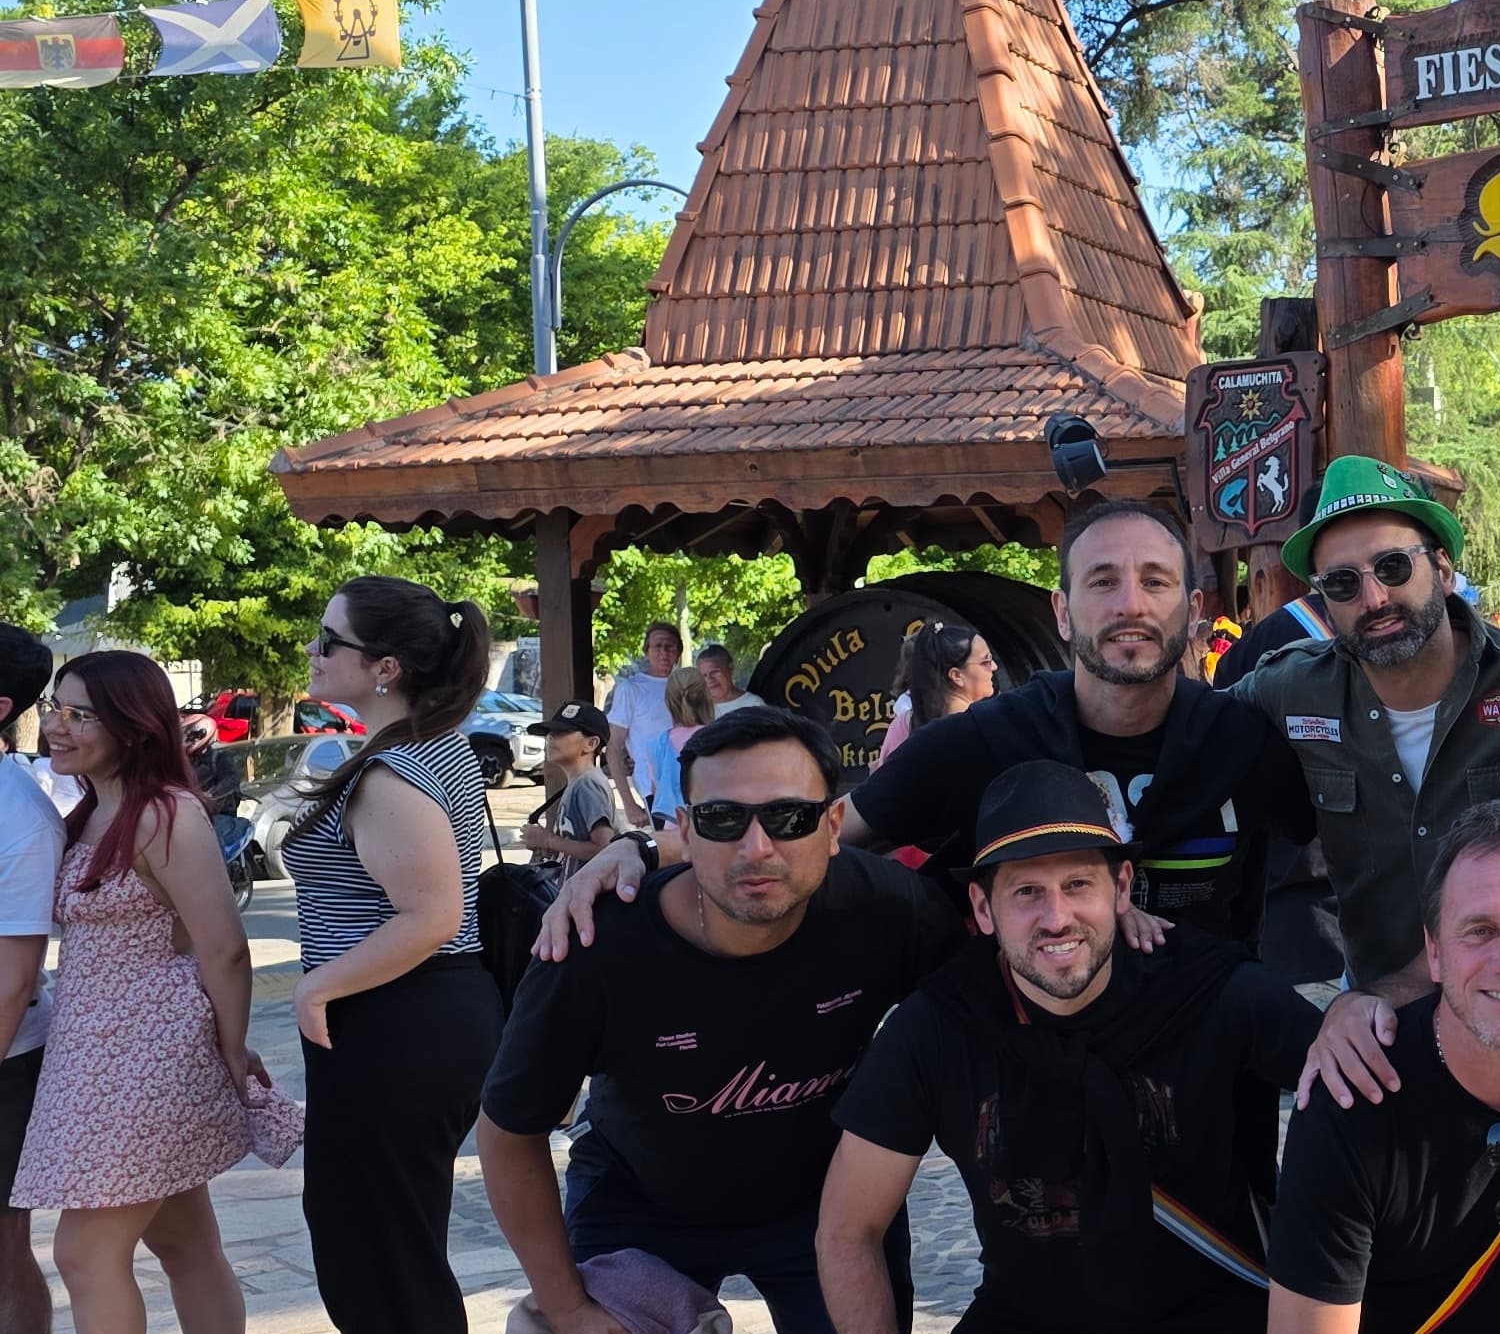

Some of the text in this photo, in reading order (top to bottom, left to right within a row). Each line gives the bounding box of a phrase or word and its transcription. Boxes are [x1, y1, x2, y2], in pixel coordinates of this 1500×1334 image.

[1218, 370, 1283, 390] CALAMUCHITA
[1211, 420, 1295, 485] Villa General Belgrano
[784, 626, 865, 708] Villa
[1288, 725, 1339, 737] MOTORCYCLES
